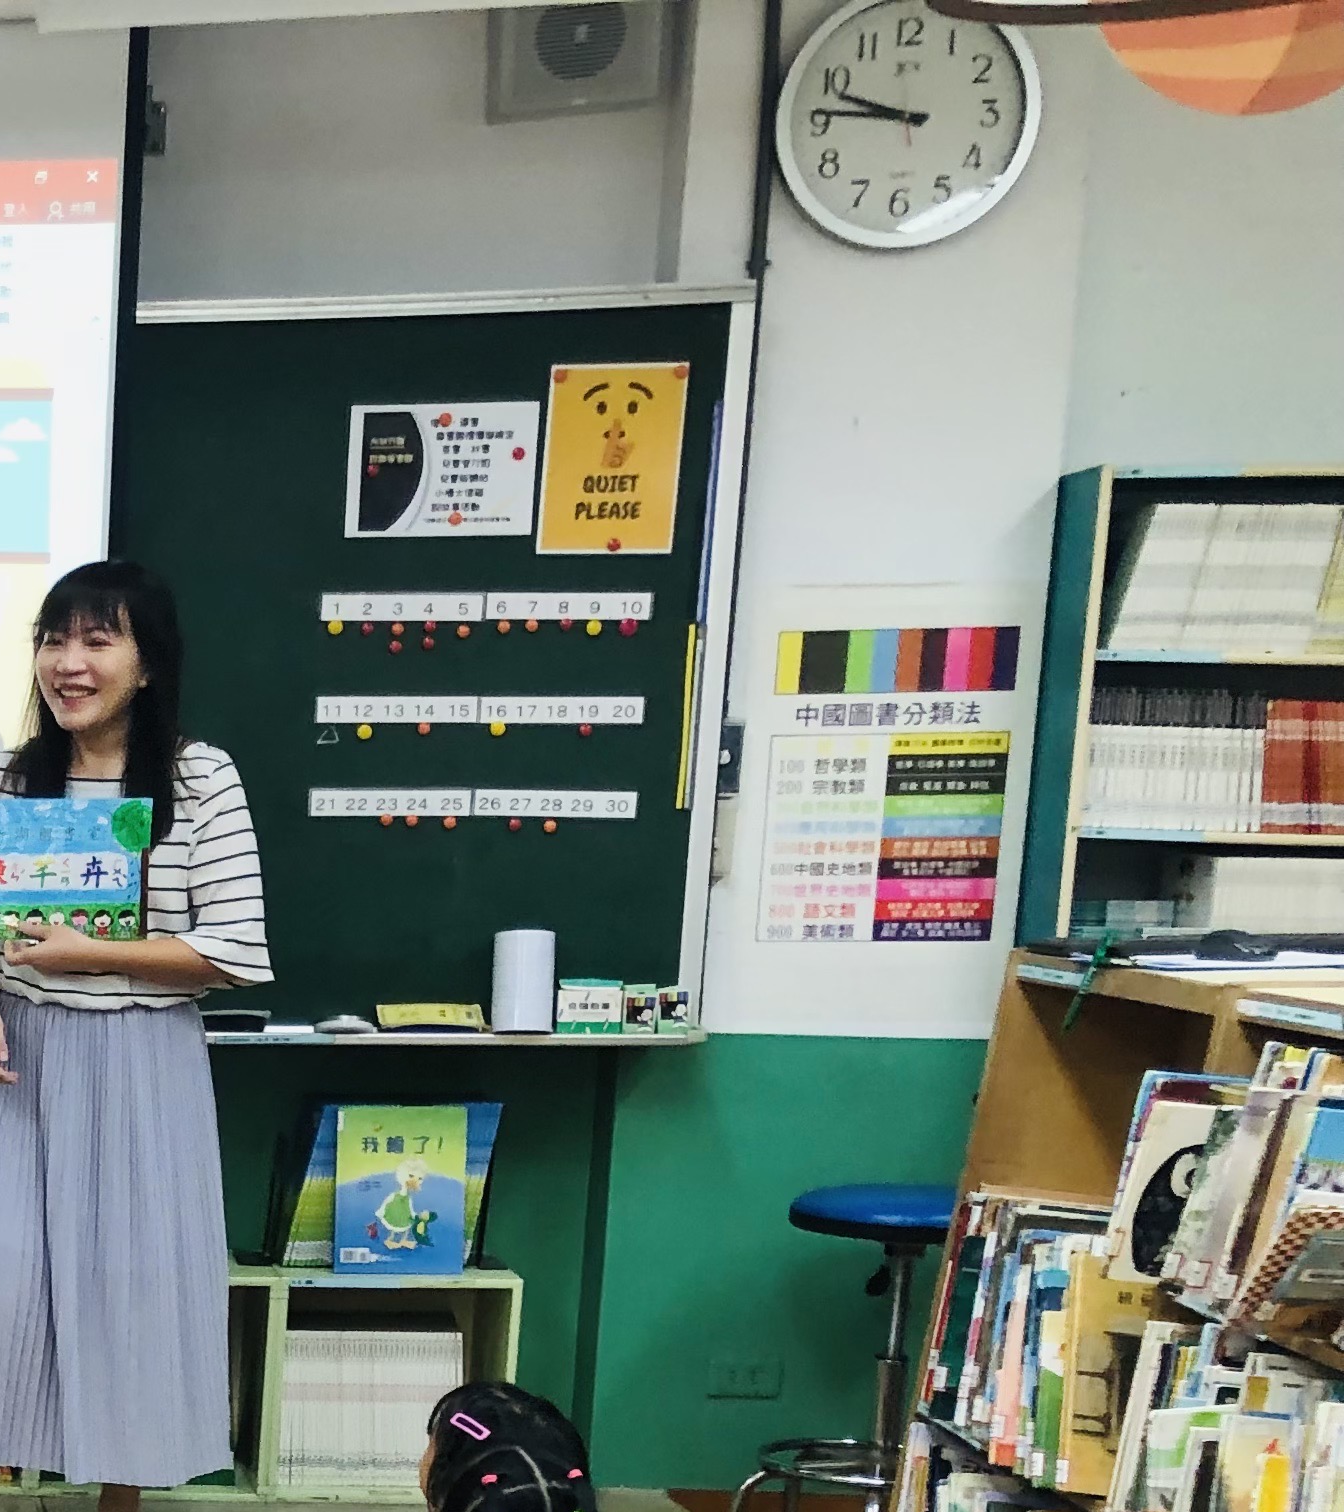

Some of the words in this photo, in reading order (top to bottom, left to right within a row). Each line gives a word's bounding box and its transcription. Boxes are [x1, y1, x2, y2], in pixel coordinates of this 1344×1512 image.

[897, 16, 924, 47] 12
[948, 29, 955, 55] 1
[857, 32, 877, 61] 11
[823, 64, 850, 96] 10
[972, 54, 993, 83] 2
[810, 108, 832, 137] 9
[980, 99, 1000, 128] 3
[818, 149, 840, 179] 8
[963, 143, 982, 170] 4
[851, 179, 870, 208] 7
[933, 175, 952, 203] 5
[889, 189, 910, 217] 6
[583, 474, 640, 493] QUIET
[574, 501, 642, 520] PLEASE
[362, 602, 373, 616] 2
[392, 602, 403, 616] 3
[423, 602, 434, 615] 4
[458, 602, 469, 616] 5
[496, 600, 507, 614] 6
[529, 600, 538, 613] 7
[558, 600, 569, 615] 8
[589, 600, 601, 615] 9
[621, 601, 643, 615] 10
[323, 704, 341, 717] 11
[353, 704, 373, 718] 12
[383, 704, 405, 718] 13
[414, 704, 435, 718] 14
[449, 704, 470, 718] 15
[487, 704, 507, 718] 16
[516, 705, 537, 717] 17
[547, 704, 568, 719] 18
[578, 705, 599, 718] 19
[612, 704, 636, 718] 20
[796, 701, 982, 727] 中國圖書分類法
[814, 757, 867, 774] 哲學類
[776, 780, 803, 795] 200
[812, 779, 866, 795] 宗教類
[316, 798, 335, 812] 21
[345, 797, 368, 811] 22
[375, 797, 398, 811] 23
[406, 797, 427, 811] 24
[440, 797, 463, 811] 25
[478, 797, 501, 811] 26
[509, 797, 532, 811] 27
[539, 798, 563, 812] 28
[570, 798, 594, 813] 29
[605, 799, 629, 813] 30
[793, 862, 873, 877] 中國史地類
[802, 902, 856, 919] 語文類
[802, 924, 855, 939] 美術類
